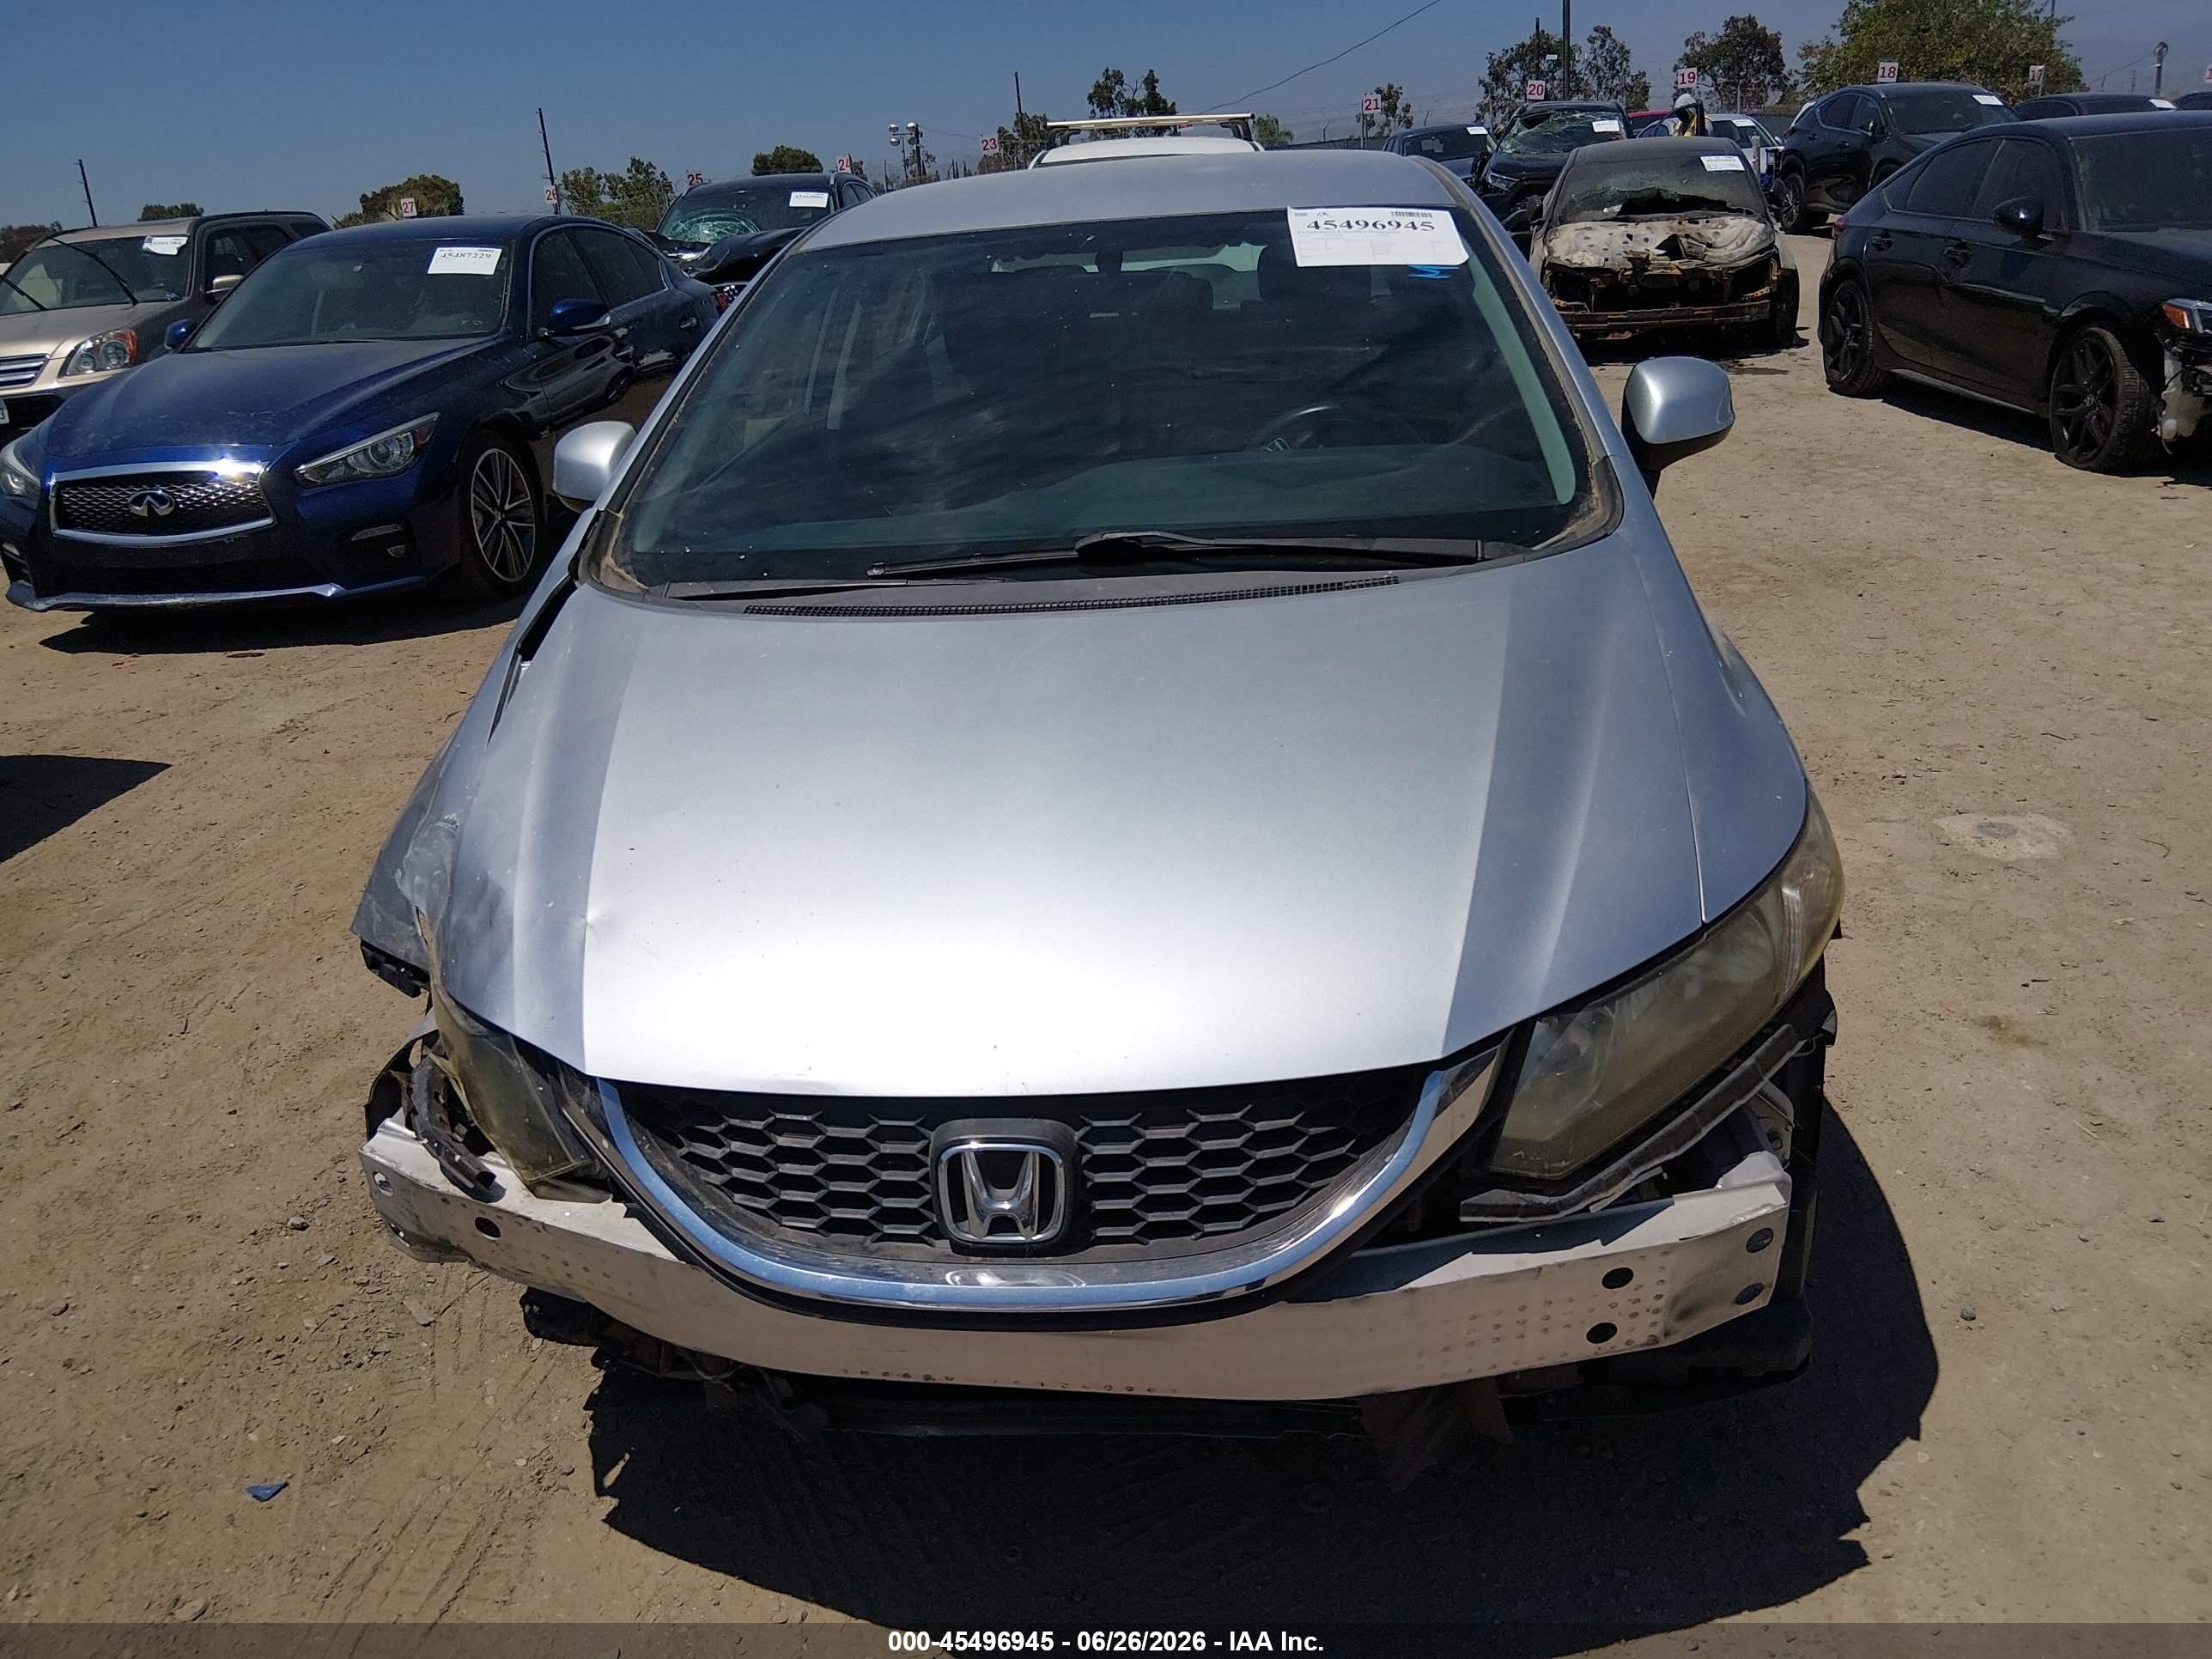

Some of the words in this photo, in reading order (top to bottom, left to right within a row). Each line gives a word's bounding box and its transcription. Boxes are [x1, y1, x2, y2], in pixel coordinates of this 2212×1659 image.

[1680, 71, 1696, 85] 19
[1879, 66, 1897, 79] 18
[2030, 69, 2043, 82] 17
[1528, 83, 1544, 96] 20
[1364, 98, 1380, 111] 21
[981, 138, 998, 151] 23
[687, 173, 703, 186] 25
[402, 201, 414, 214] 27
[1306, 219, 1435, 232] 45496945
